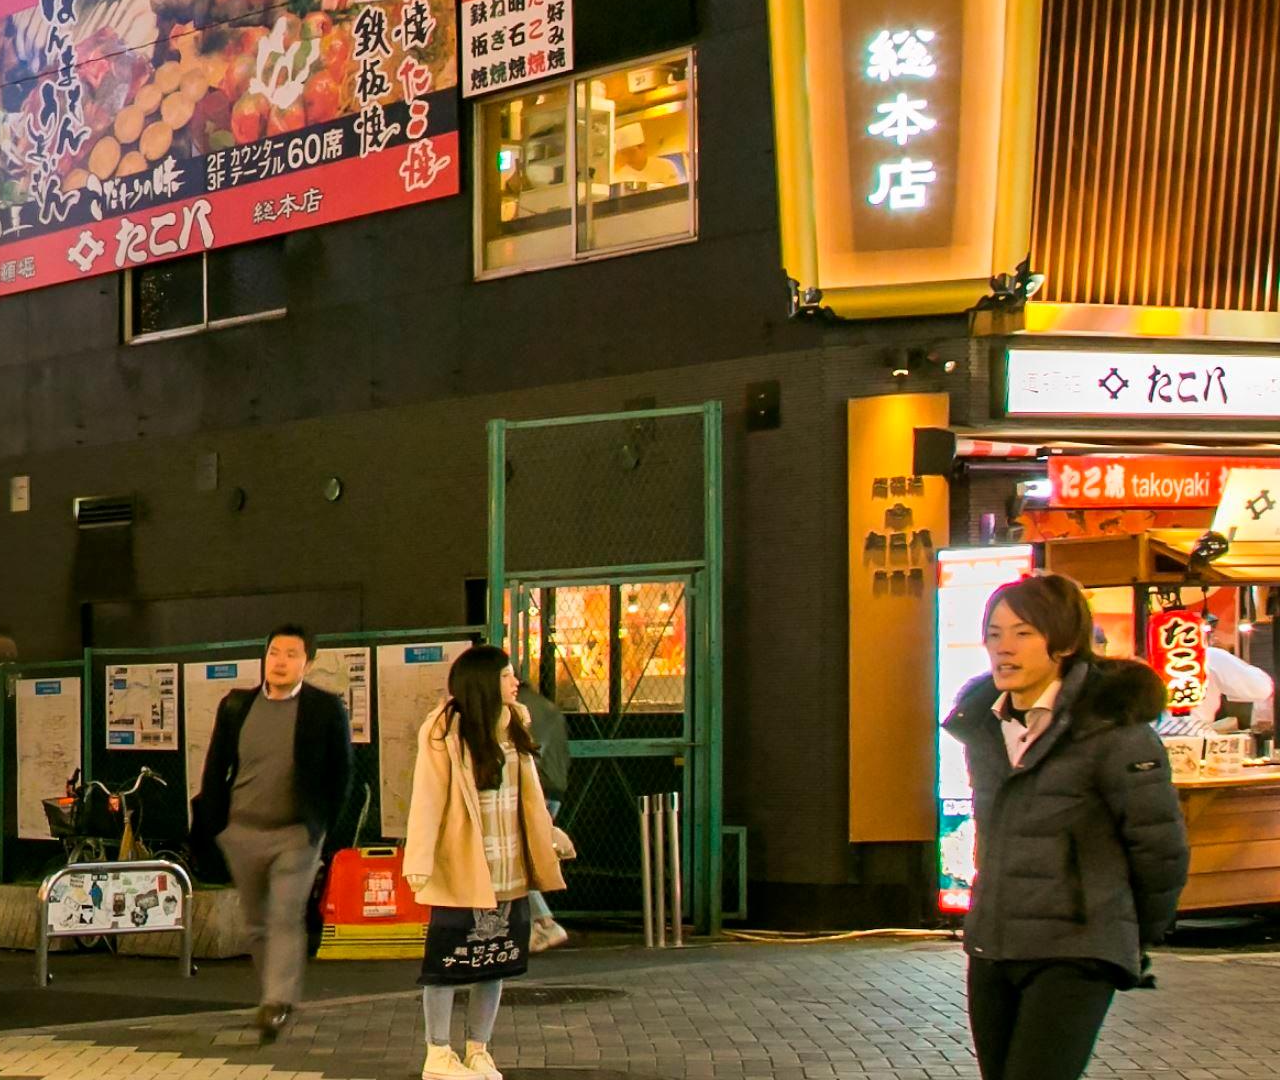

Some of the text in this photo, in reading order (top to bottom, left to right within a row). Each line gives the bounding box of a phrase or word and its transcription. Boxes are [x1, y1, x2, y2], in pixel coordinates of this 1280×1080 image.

[470, 3, 489, 91] 鉄板焼
[353, 7, 401, 157] 鉄板焼
[867, 30, 938, 210] 総本店
[207, 139, 284, 172] 2F カウンター
[287, 128, 344, 169] 60席
[207, 156, 285, 191] 3F テーブル
[114, 188, 323, 268] たこ八 総本店
[1147, 364, 1228, 405] たこ八
[1059, 463, 1127, 500] たこ焼
[1131, 471, 1211, 503] takoyaki
[442, 948, 520, 968] サービスの店
